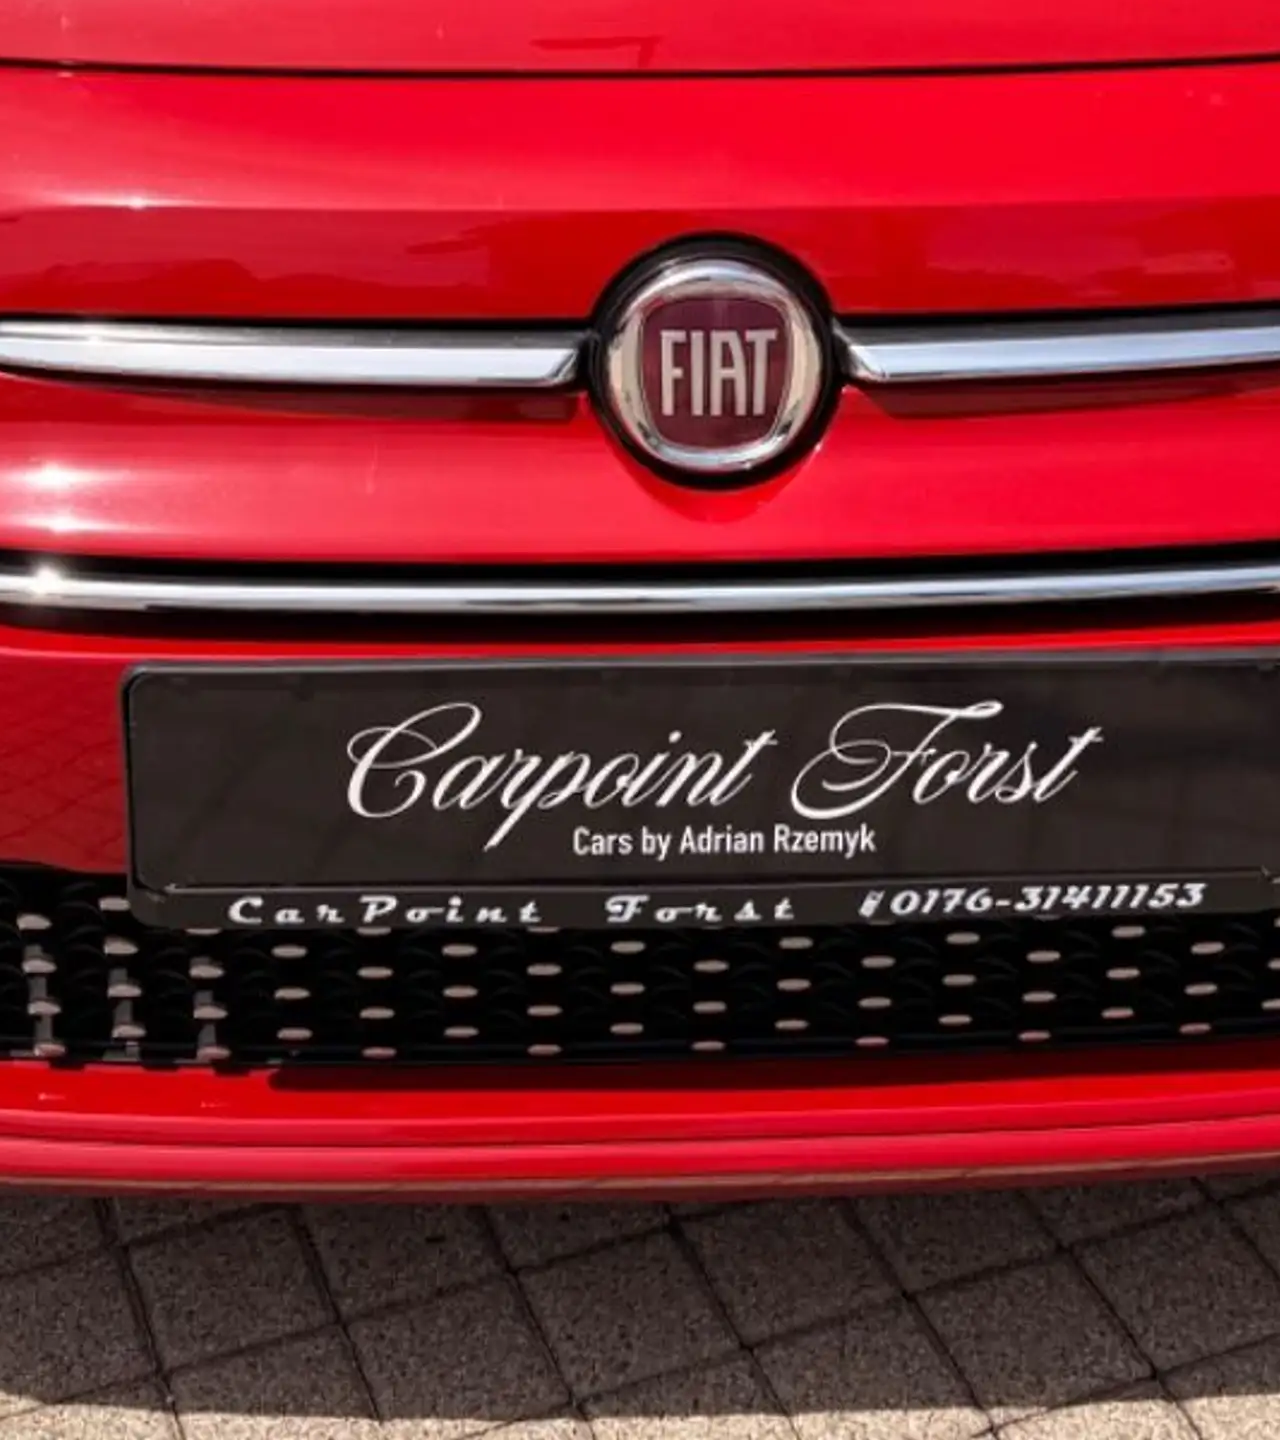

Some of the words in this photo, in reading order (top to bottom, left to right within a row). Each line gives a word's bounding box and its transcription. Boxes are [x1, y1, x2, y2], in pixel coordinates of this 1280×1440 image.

[660, 329, 778, 417] FIAT
[347, 702, 778, 852] Carpoint
[791, 700, 1103, 819] Forst
[573, 826, 632, 855] Cars
[641, 825, 671, 860] by
[680, 824, 764, 853] Adrian
[773, 823, 876, 858] Rzemyk
[228, 896, 542, 924] CarPoint
[605, 894, 795, 922] Forst
[889, 883, 1208, 916] 0176-31411153
